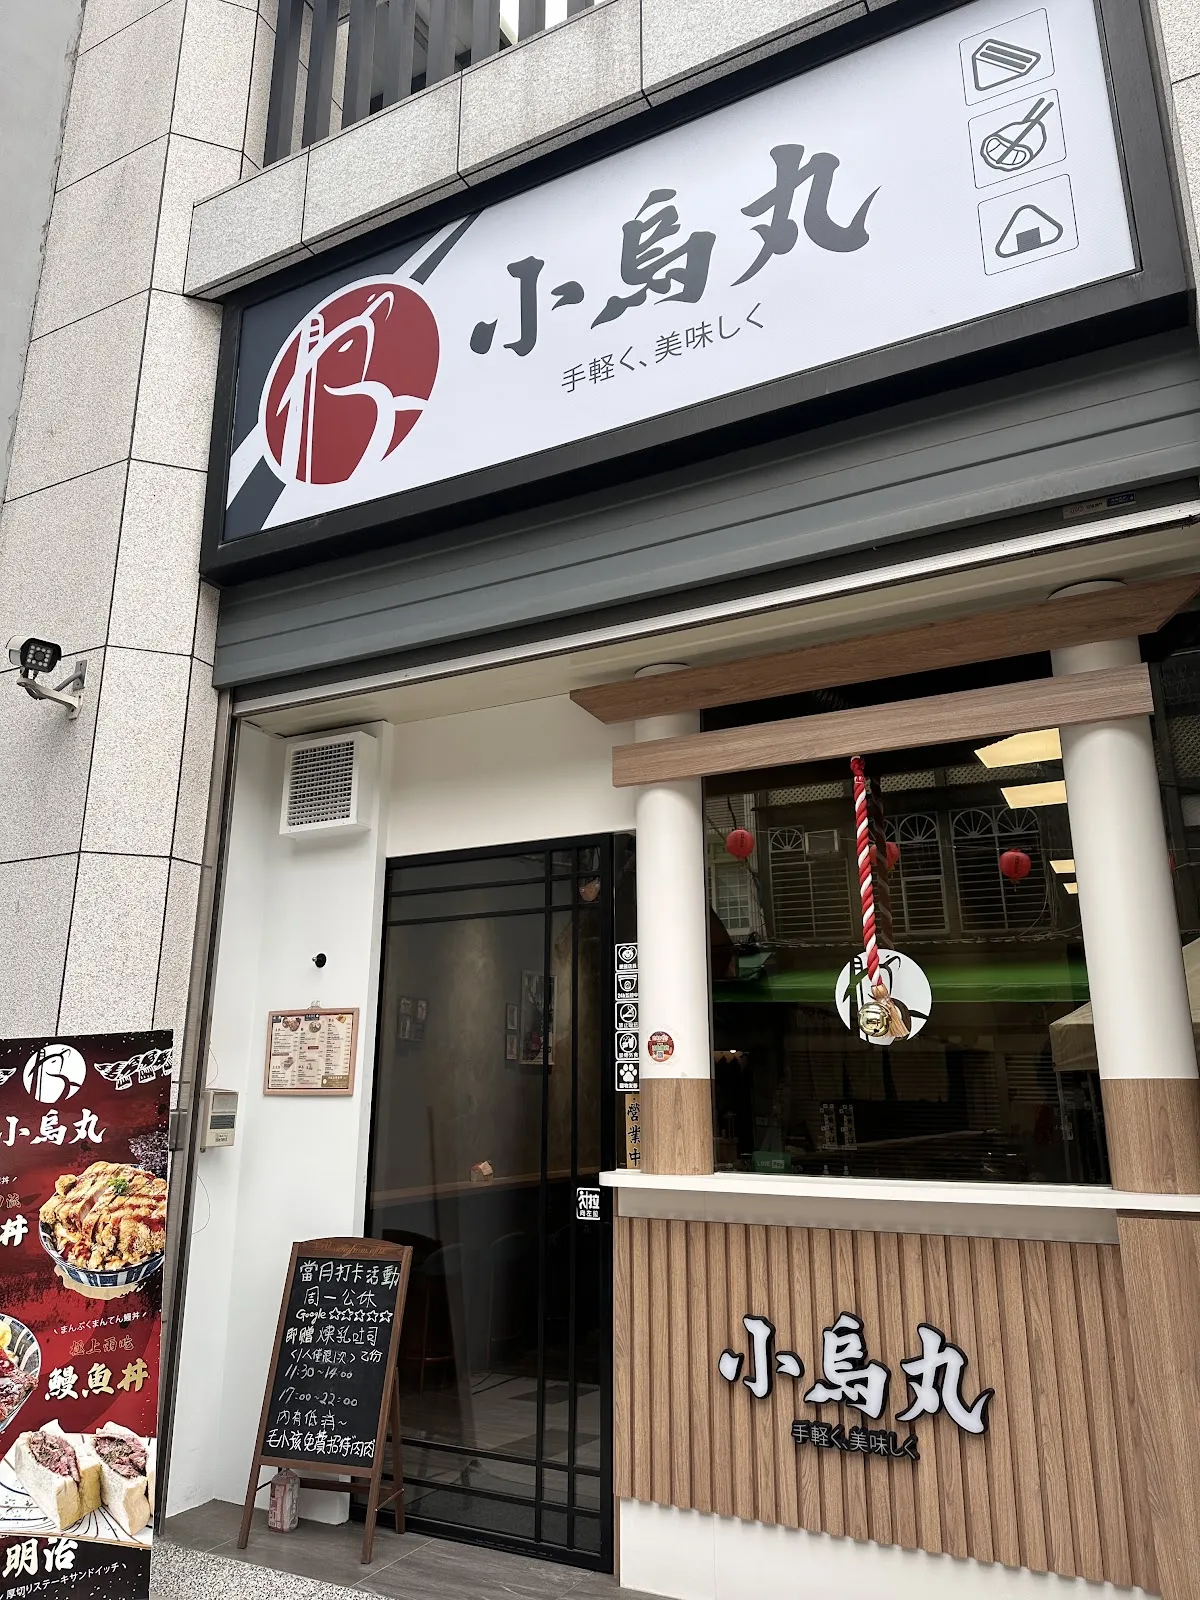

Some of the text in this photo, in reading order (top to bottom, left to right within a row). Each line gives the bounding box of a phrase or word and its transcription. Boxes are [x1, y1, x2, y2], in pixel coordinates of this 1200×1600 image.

[469, 144, 882, 357] 小烏丸
[561, 303, 764, 393] 手軽く、美味しく
[627, 1102, 641, 1167] 營業中
[300, 1260, 400, 1290] 當月打卡活動
[304, 1285, 377, 1308] 周一公休
[296, 1307, 327, 1325] Google
[718, 1311, 995, 1434] 小烏丸
[791, 1420, 920, 1460] 手軽く、美味しく
